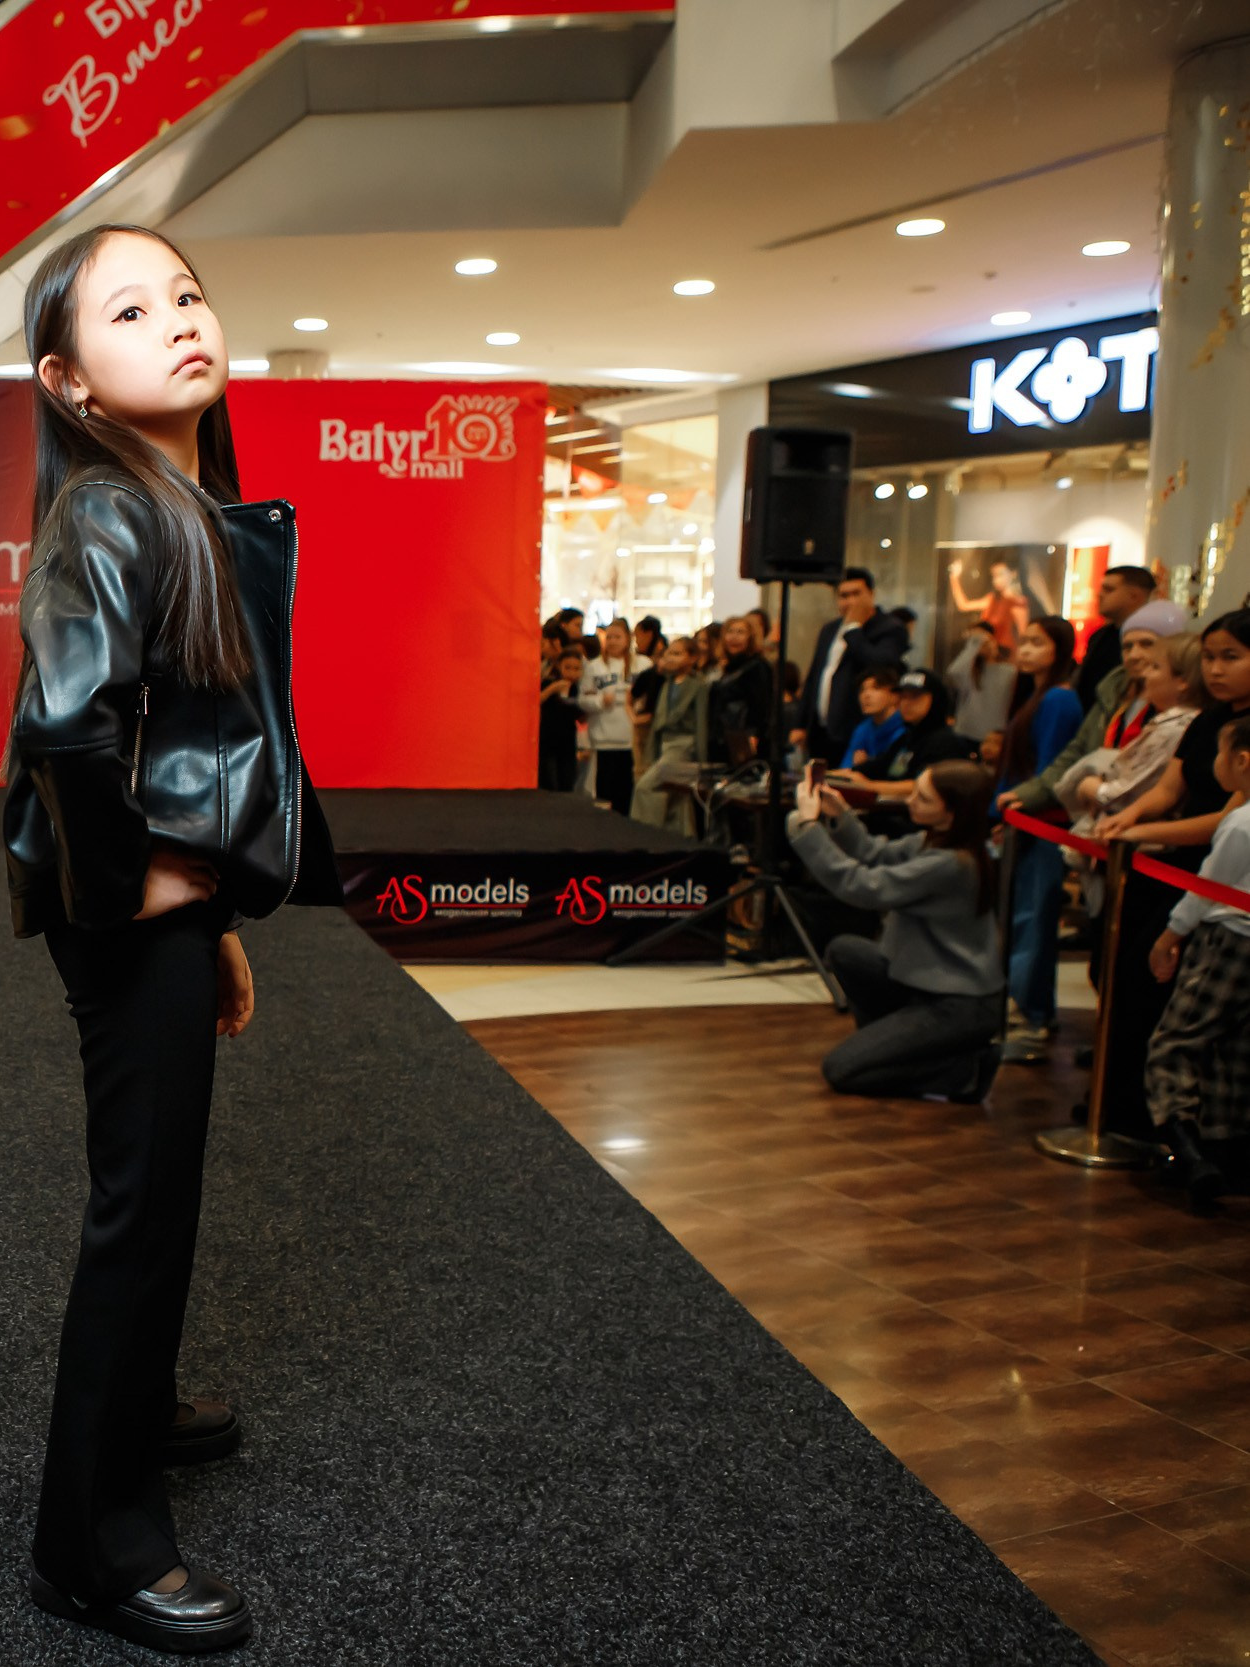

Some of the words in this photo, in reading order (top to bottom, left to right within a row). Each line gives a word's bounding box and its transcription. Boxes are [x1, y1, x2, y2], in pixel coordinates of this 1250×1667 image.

[319, 418, 429, 479] Batyr
[410, 457, 464, 479] mall
[376, 874, 428, 925] AS
[431, 877, 530, 903] models
[555, 875, 607, 925] AS
[609, 878, 708, 904] models
